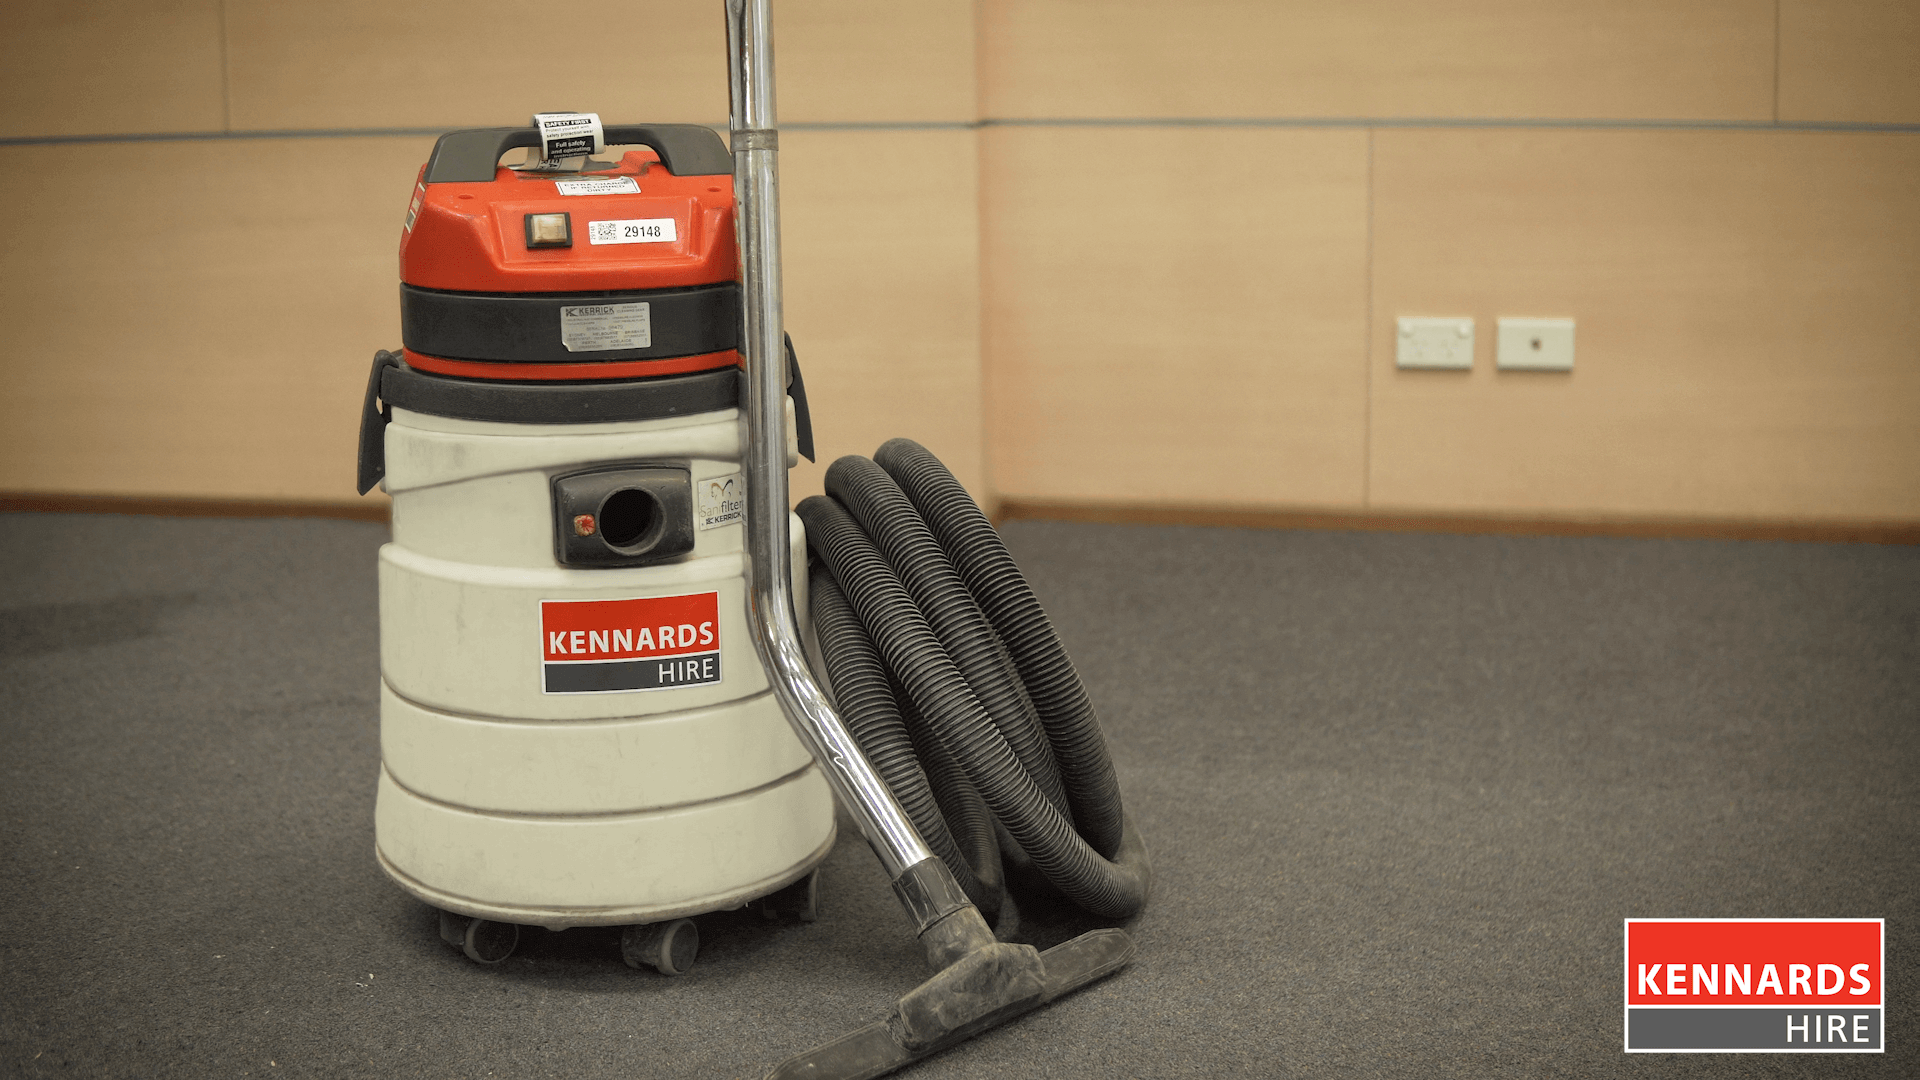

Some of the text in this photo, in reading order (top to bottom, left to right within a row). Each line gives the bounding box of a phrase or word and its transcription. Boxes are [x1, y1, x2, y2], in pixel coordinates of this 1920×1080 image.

[563, 146, 591, 154] operating
[624, 225, 661, 238] 29148
[579, 306, 615, 314] KERRICK
[714, 511, 742, 524] KERRICK
[549, 621, 714, 655] KENNARDS
[658, 657, 714, 684] HIRE
